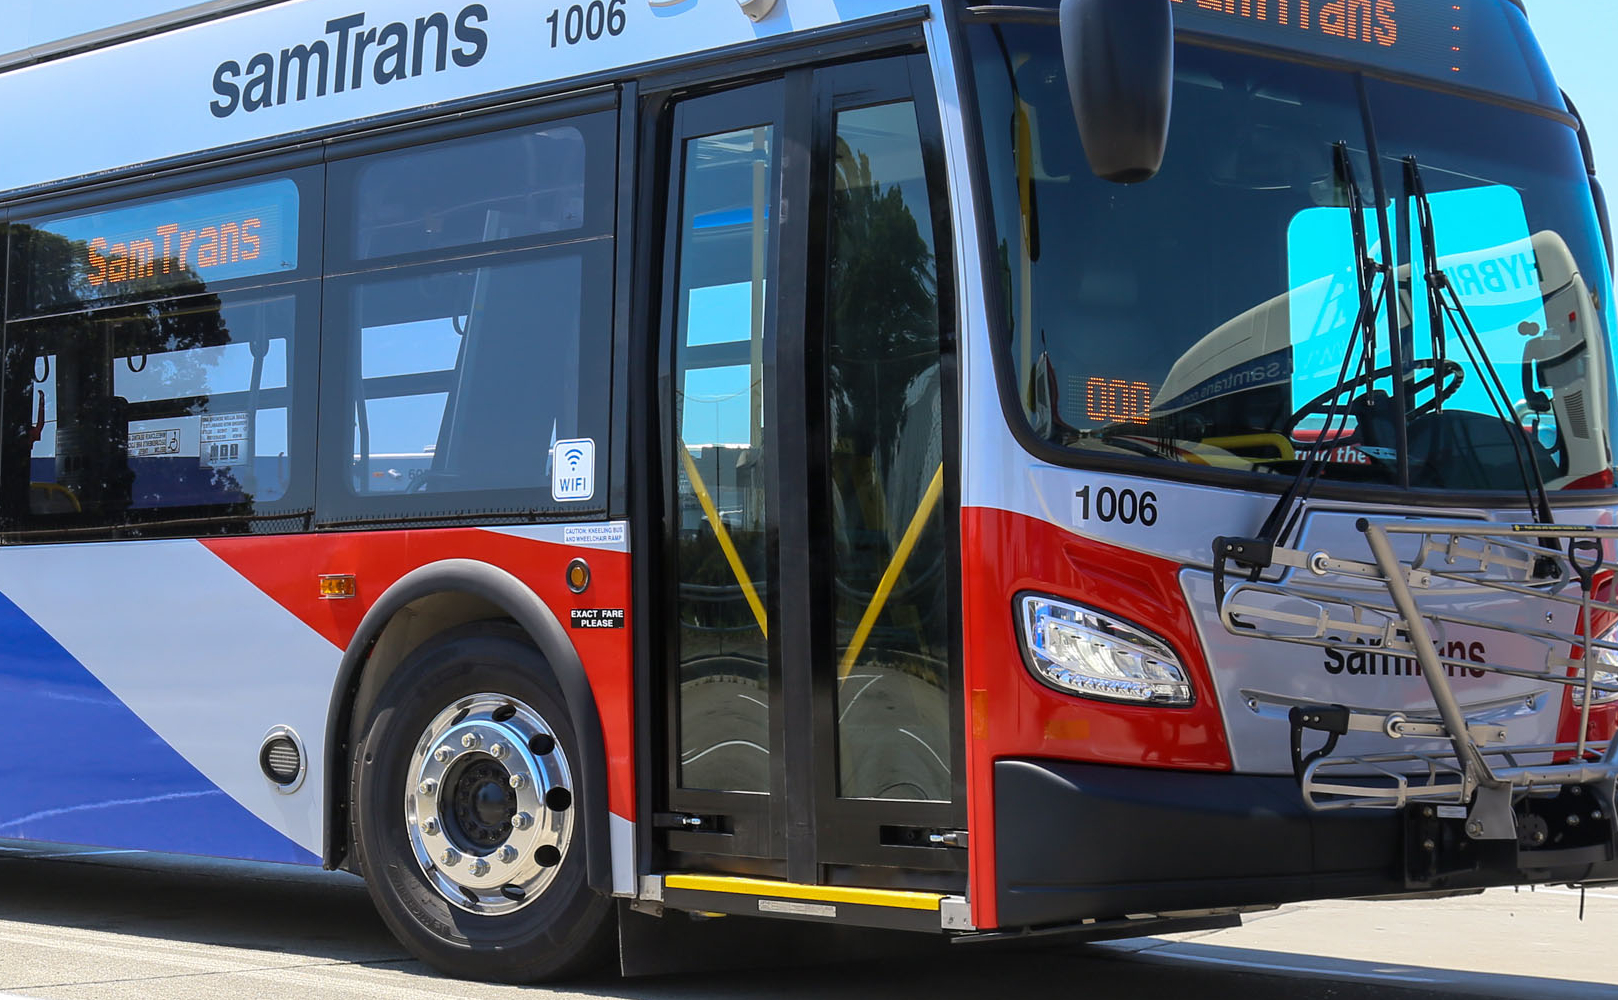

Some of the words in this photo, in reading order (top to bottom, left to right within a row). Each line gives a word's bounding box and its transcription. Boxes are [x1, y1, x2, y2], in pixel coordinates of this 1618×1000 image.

[546, 0, 627, 48] 1006
[209, 3, 489, 119] samTrans
[87, 217, 262, 286] SamTrans
[1337, 445, 1367, 464] the
[559, 477, 586, 492] WIFI
[1075, 485, 1158, 526] 1006
[571, 609, 598, 618] EXACT
[601, 609, 624, 618] FARE
[580, 619, 614, 628] PLEASE
